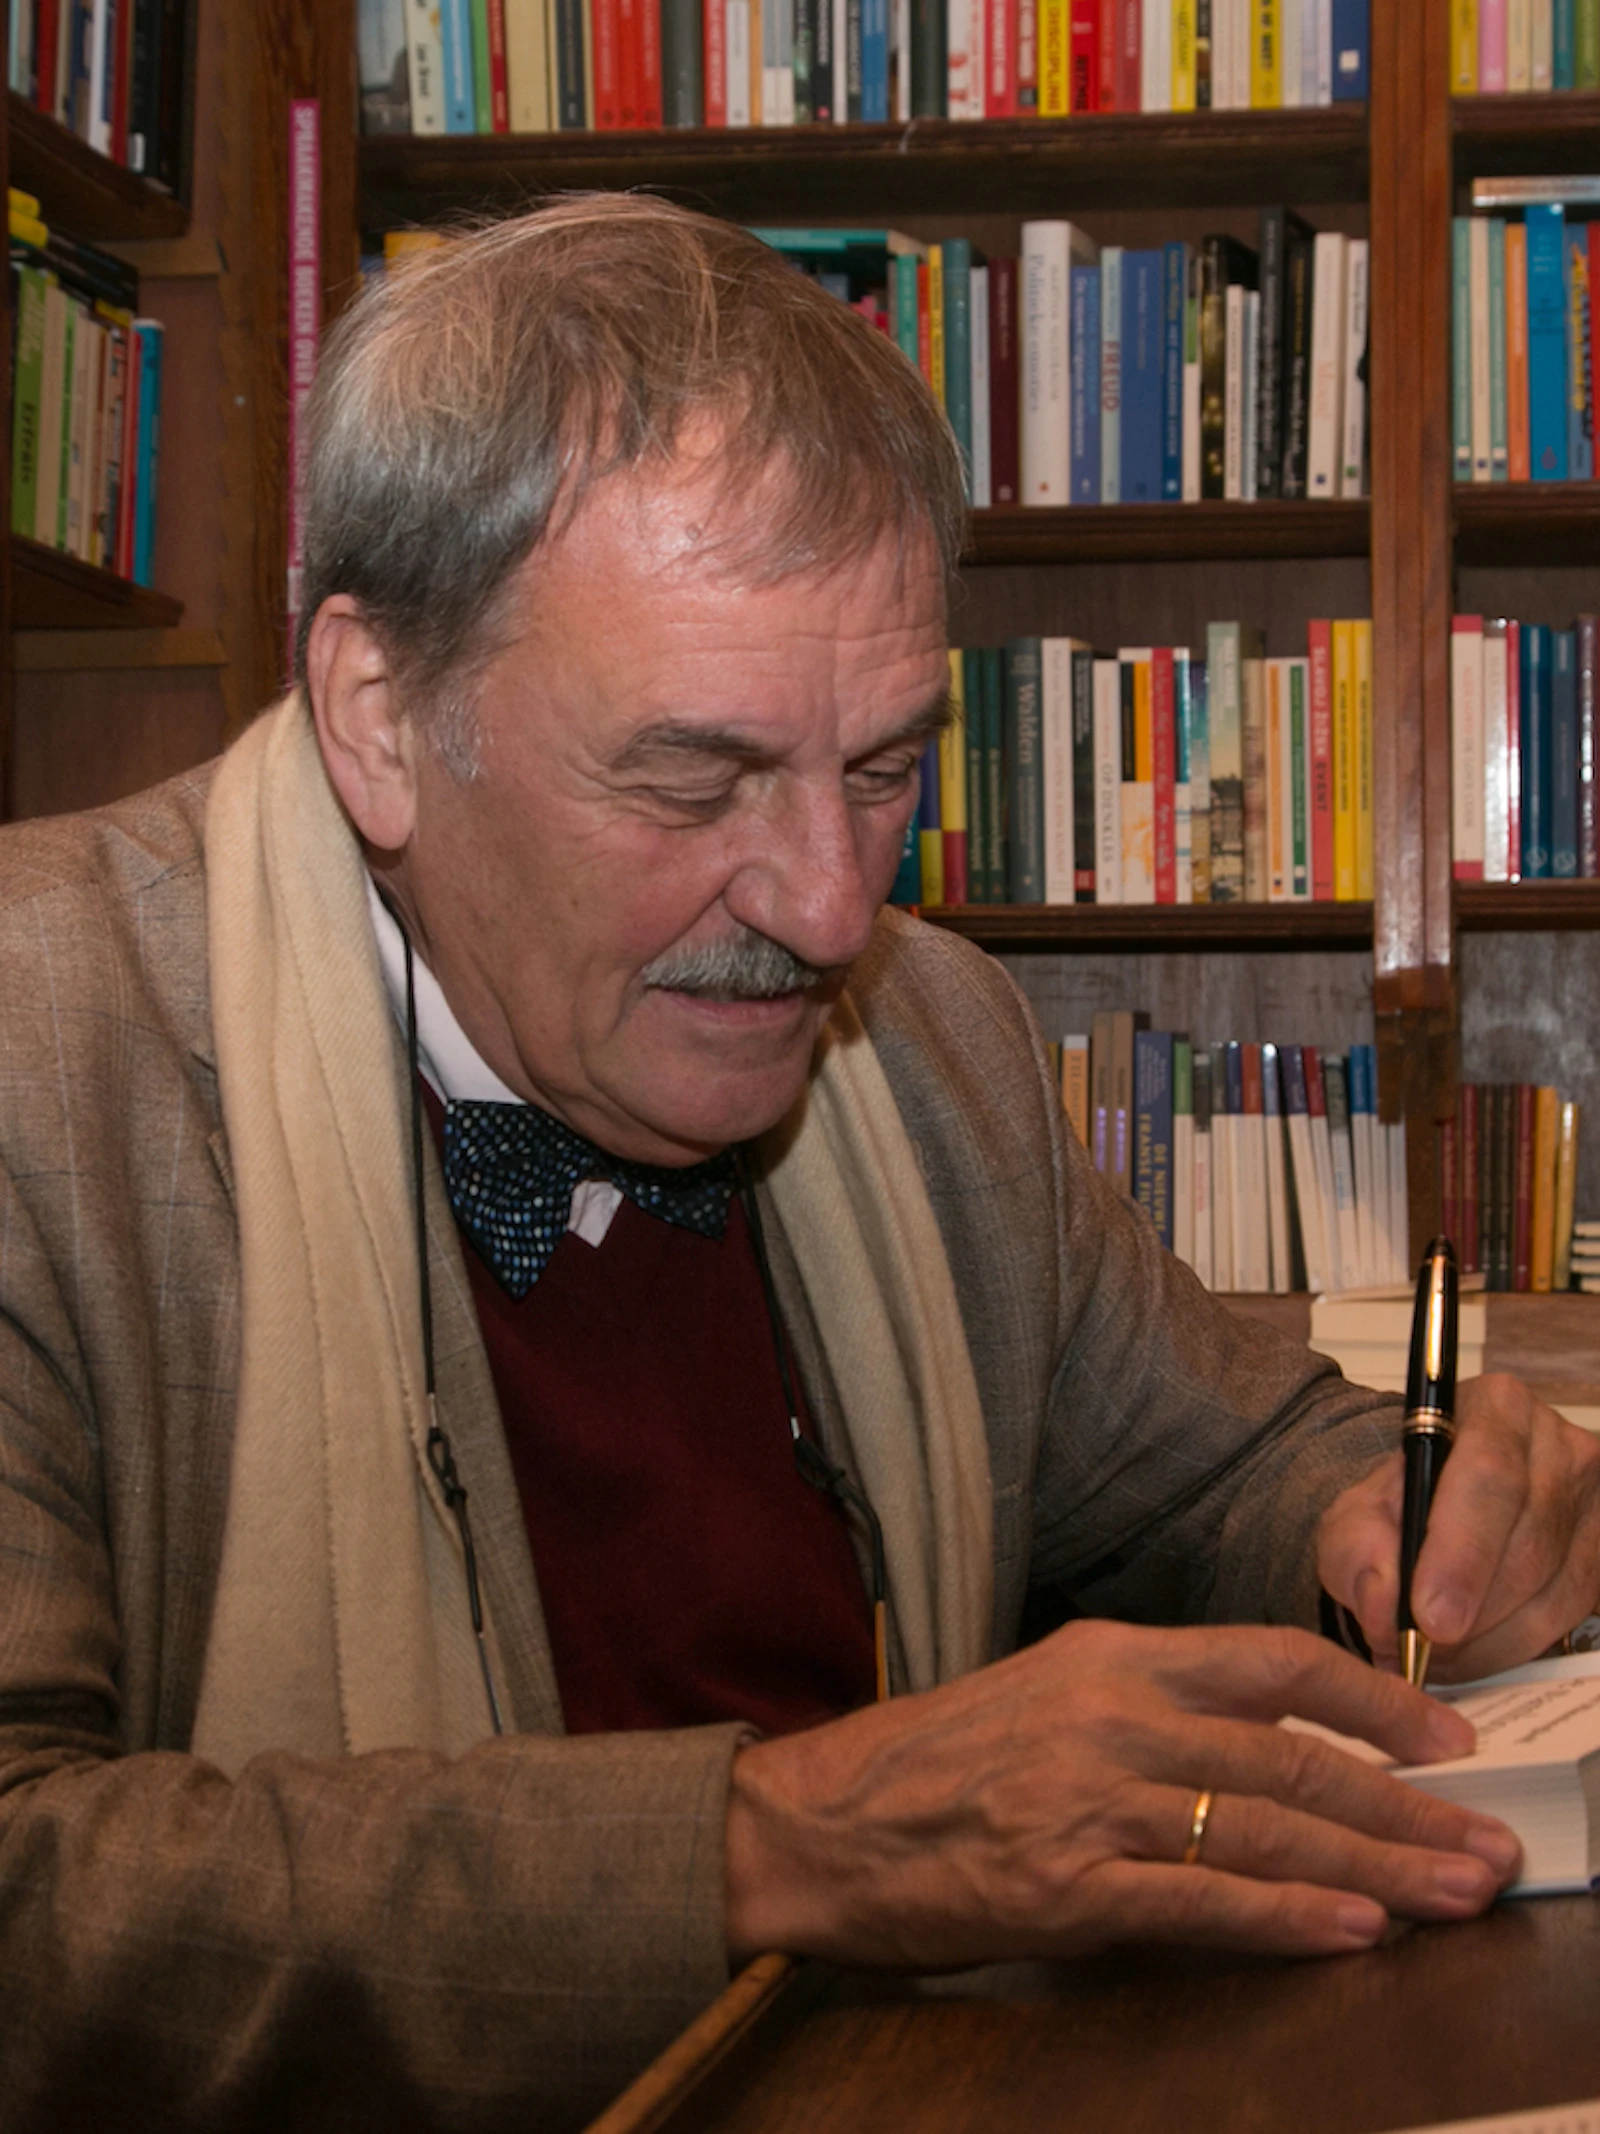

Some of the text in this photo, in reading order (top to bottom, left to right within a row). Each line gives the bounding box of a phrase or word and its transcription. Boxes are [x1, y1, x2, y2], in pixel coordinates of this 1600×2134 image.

[1047, 6, 1060, 111] DISCIPLINE
[294, 106, 315, 260] SPRAAKMAKENDE
[294, 265, 315, 334] BOEKEN
[1028, 252, 1046, 337] Politieke
[294, 339, 313, 383] OVER
[1101, 340, 1121, 414] FREUD
[1017, 682, 1037, 764] Walden
[1312, 646, 1331, 812] SLAVOJ ŽIŽEK EVENT
[1101, 764, 1114, 784] OP
[1101, 789, 1114, 863] DENKLES
[1138, 1113, 1153, 1176] FRANSE
[1152, 1143, 1168, 1232] DE NIEUWE
